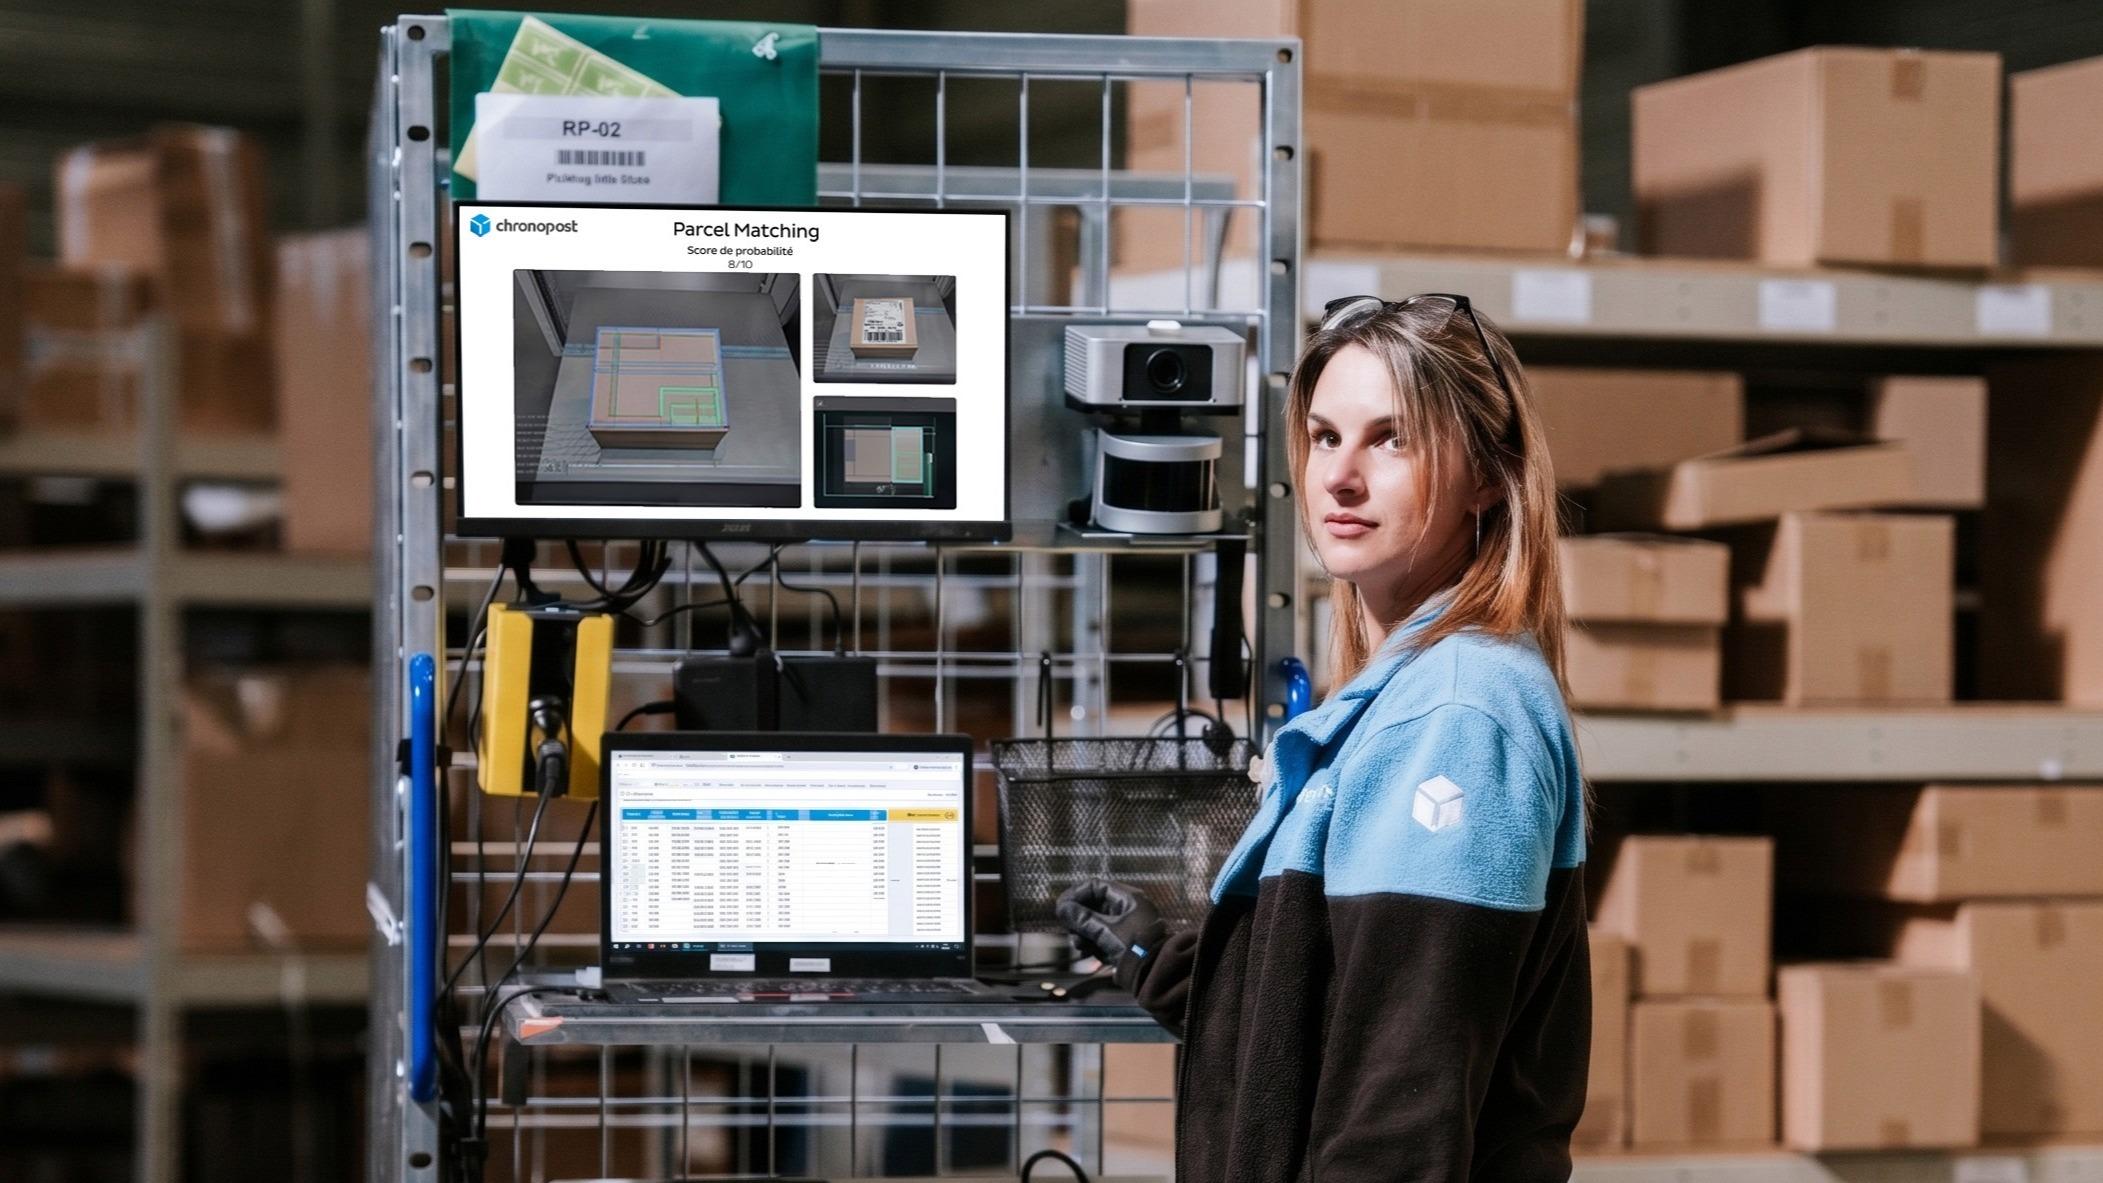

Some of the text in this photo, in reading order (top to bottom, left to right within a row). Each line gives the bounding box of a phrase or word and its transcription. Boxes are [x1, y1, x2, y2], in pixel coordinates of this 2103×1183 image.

[562, 120, 621, 138] RP-02
[495, 218, 579, 236] chronopost
[673, 221, 820, 243] Parcel Matching
[687, 245, 794, 257] Score de probabilité
[727, 260, 754, 269] 8/10
